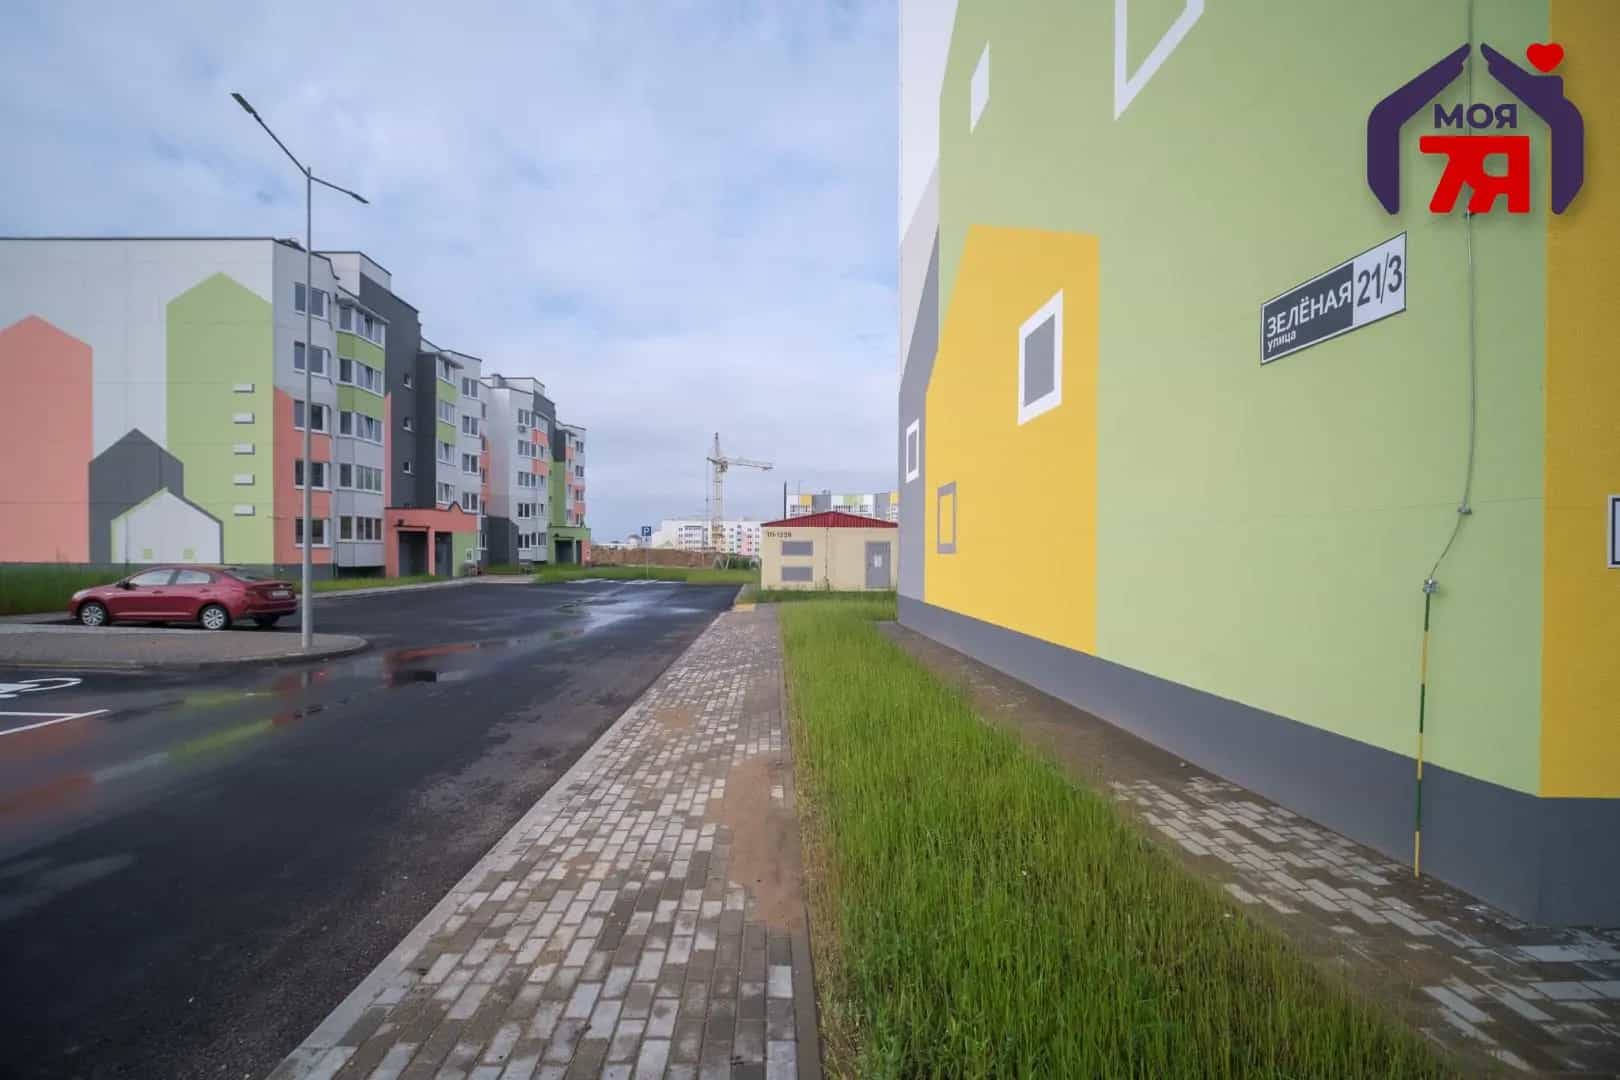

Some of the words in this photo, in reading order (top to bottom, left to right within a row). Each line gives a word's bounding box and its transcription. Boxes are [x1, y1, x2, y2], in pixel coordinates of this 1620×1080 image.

[1356, 251, 1403, 307] 21/3
[1266, 280, 1352, 338] ЗЕЛЁНАЯ
[1267, 330, 1297, 352] улица
